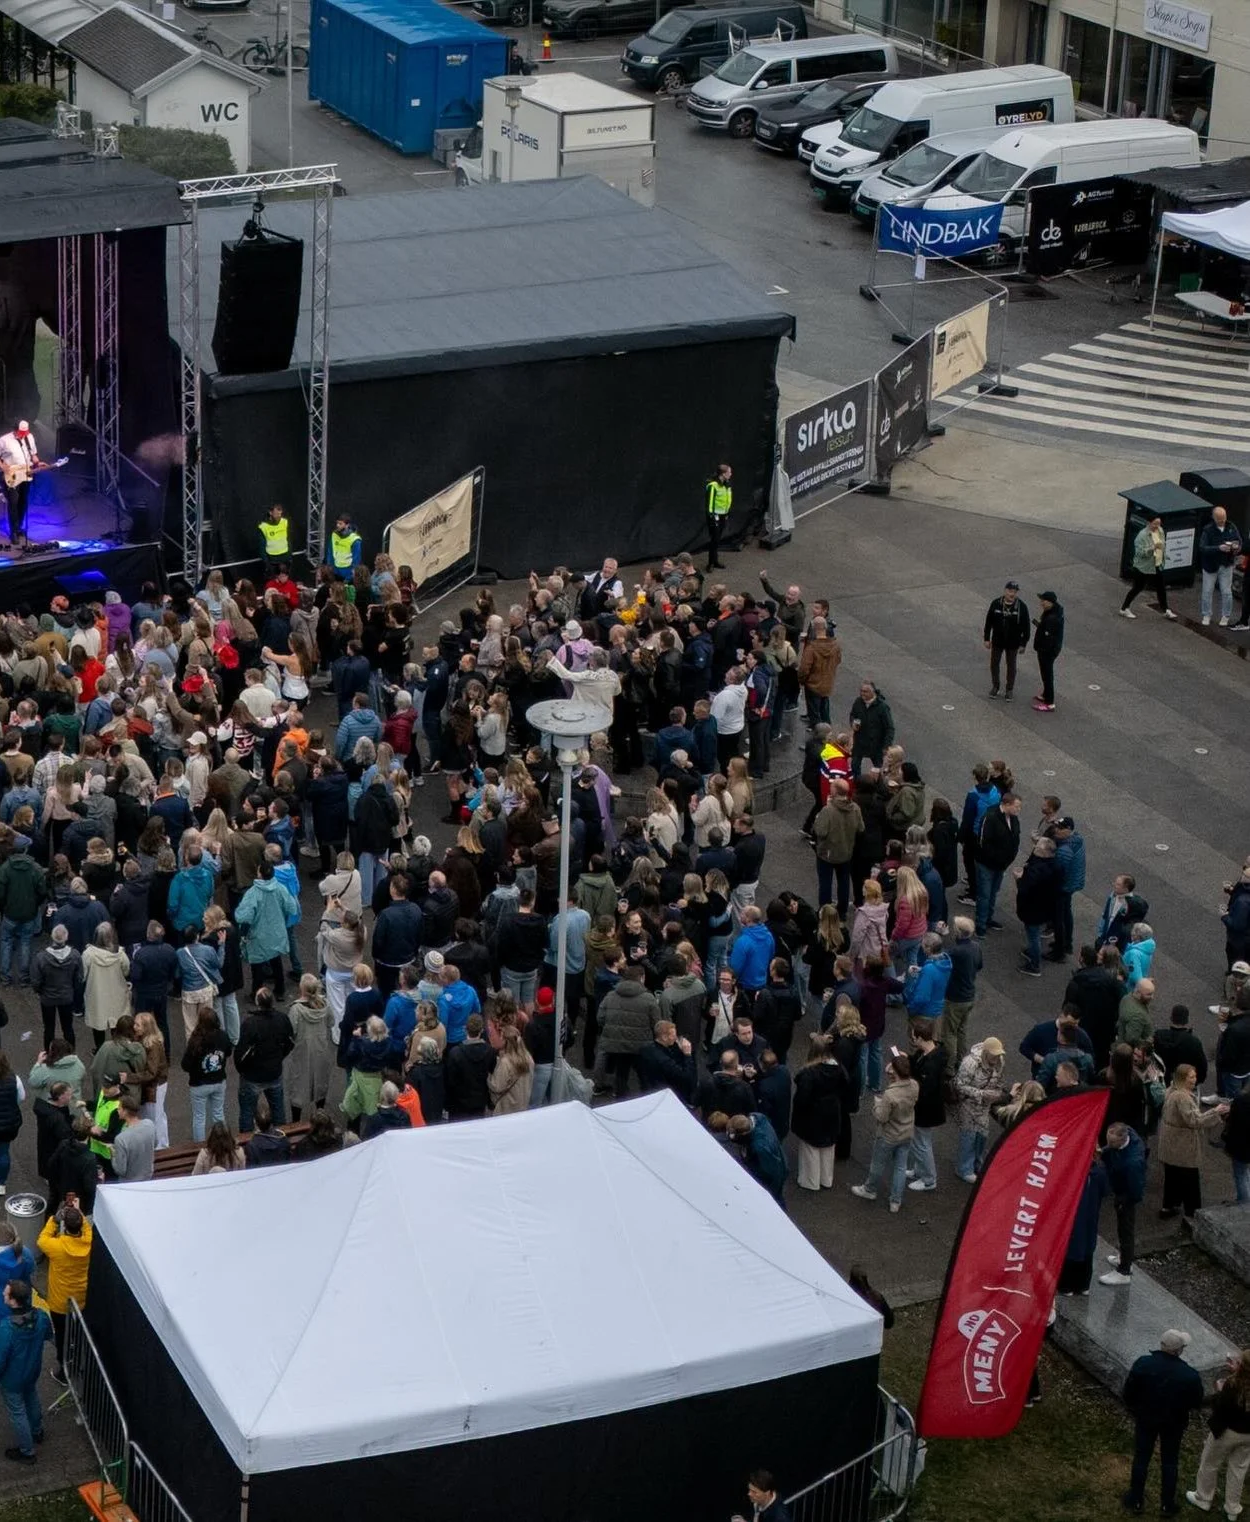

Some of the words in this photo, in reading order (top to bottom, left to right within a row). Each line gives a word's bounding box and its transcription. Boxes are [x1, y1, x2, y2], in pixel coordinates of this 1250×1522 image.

[201, 102, 239, 122] WC
[998, 111, 1043, 125] ØYRELYD
[890, 214, 996, 245] LINDBAK
[797, 401, 856, 452] sirkla
[1004, 1196, 1040, 1272] LEVERT
[1026, 1132, 1059, 1189] HJEM
[967, 1313, 981, 1333] .NO
[972, 1319, 1007, 1394] MENY
